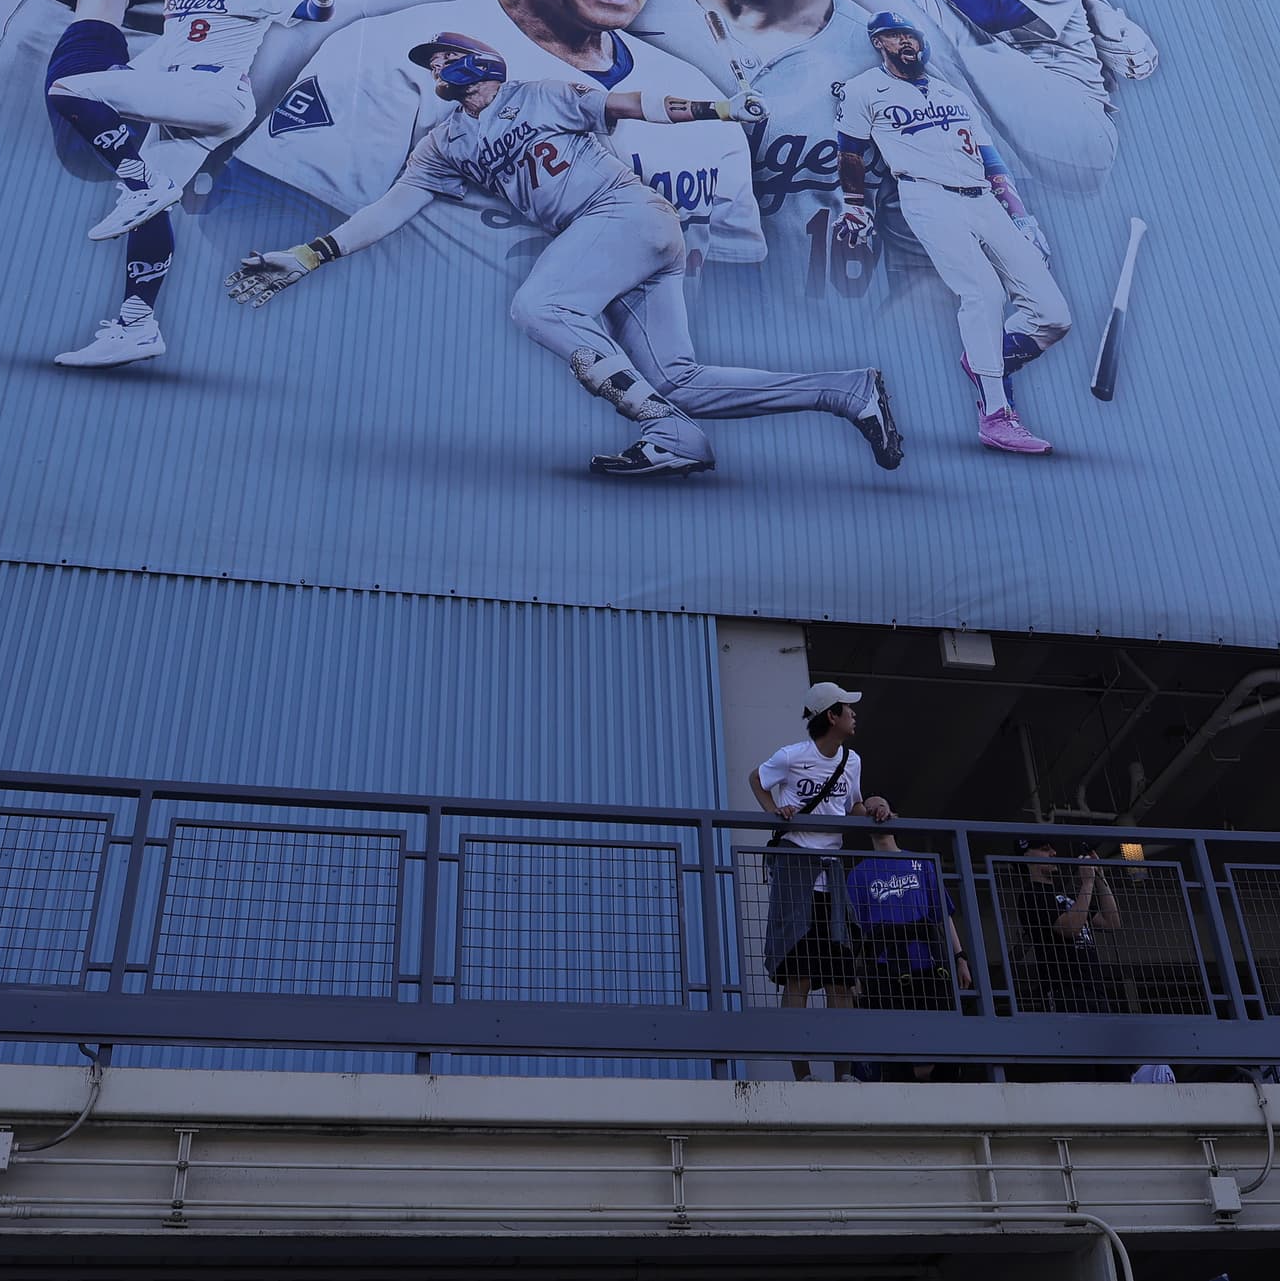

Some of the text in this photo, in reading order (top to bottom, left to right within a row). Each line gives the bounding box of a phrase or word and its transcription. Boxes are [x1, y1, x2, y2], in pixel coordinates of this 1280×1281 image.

[187, 19, 210, 42] 8
[285, 90, 315, 115] G
[458, 121, 538, 184] Dodgers
[517, 142, 569, 189] 72
[870, 874, 919, 900] Dodgers
